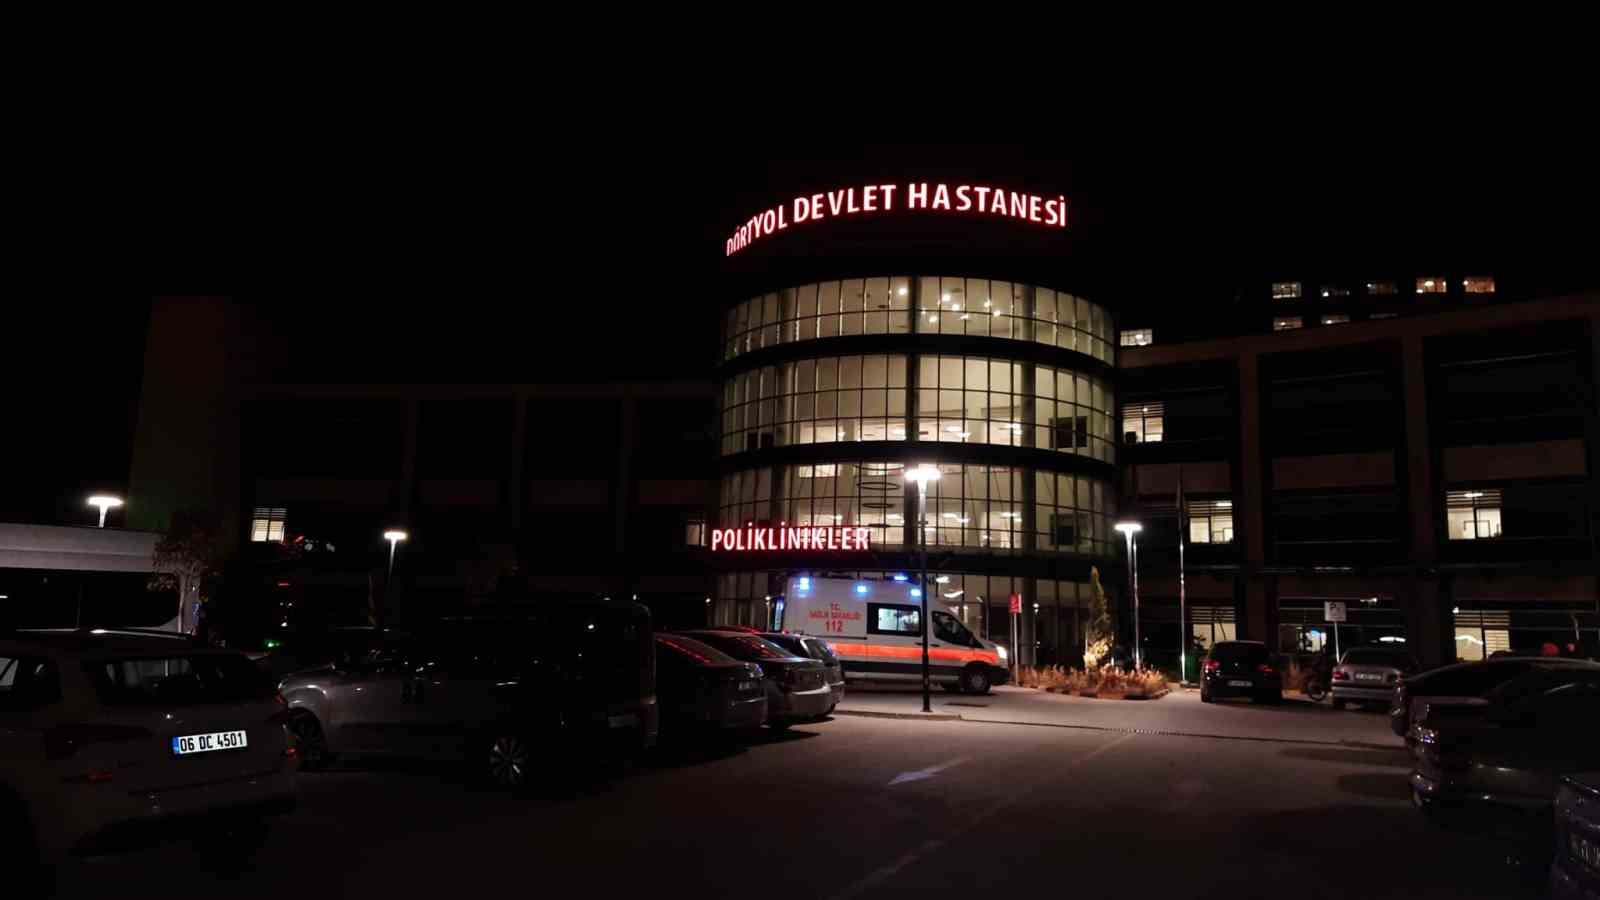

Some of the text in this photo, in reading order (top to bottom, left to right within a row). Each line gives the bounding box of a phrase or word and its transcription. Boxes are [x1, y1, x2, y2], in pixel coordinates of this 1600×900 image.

[793, 184, 897, 223] DEVLET
[908, 182, 1066, 227] HASTANESİ
[711, 521, 870, 551] POLİKLİNİKLER
[825, 620, 843, 632] 112
[180, 738, 195, 752] 06
[217, 733, 243, 747] 4501
